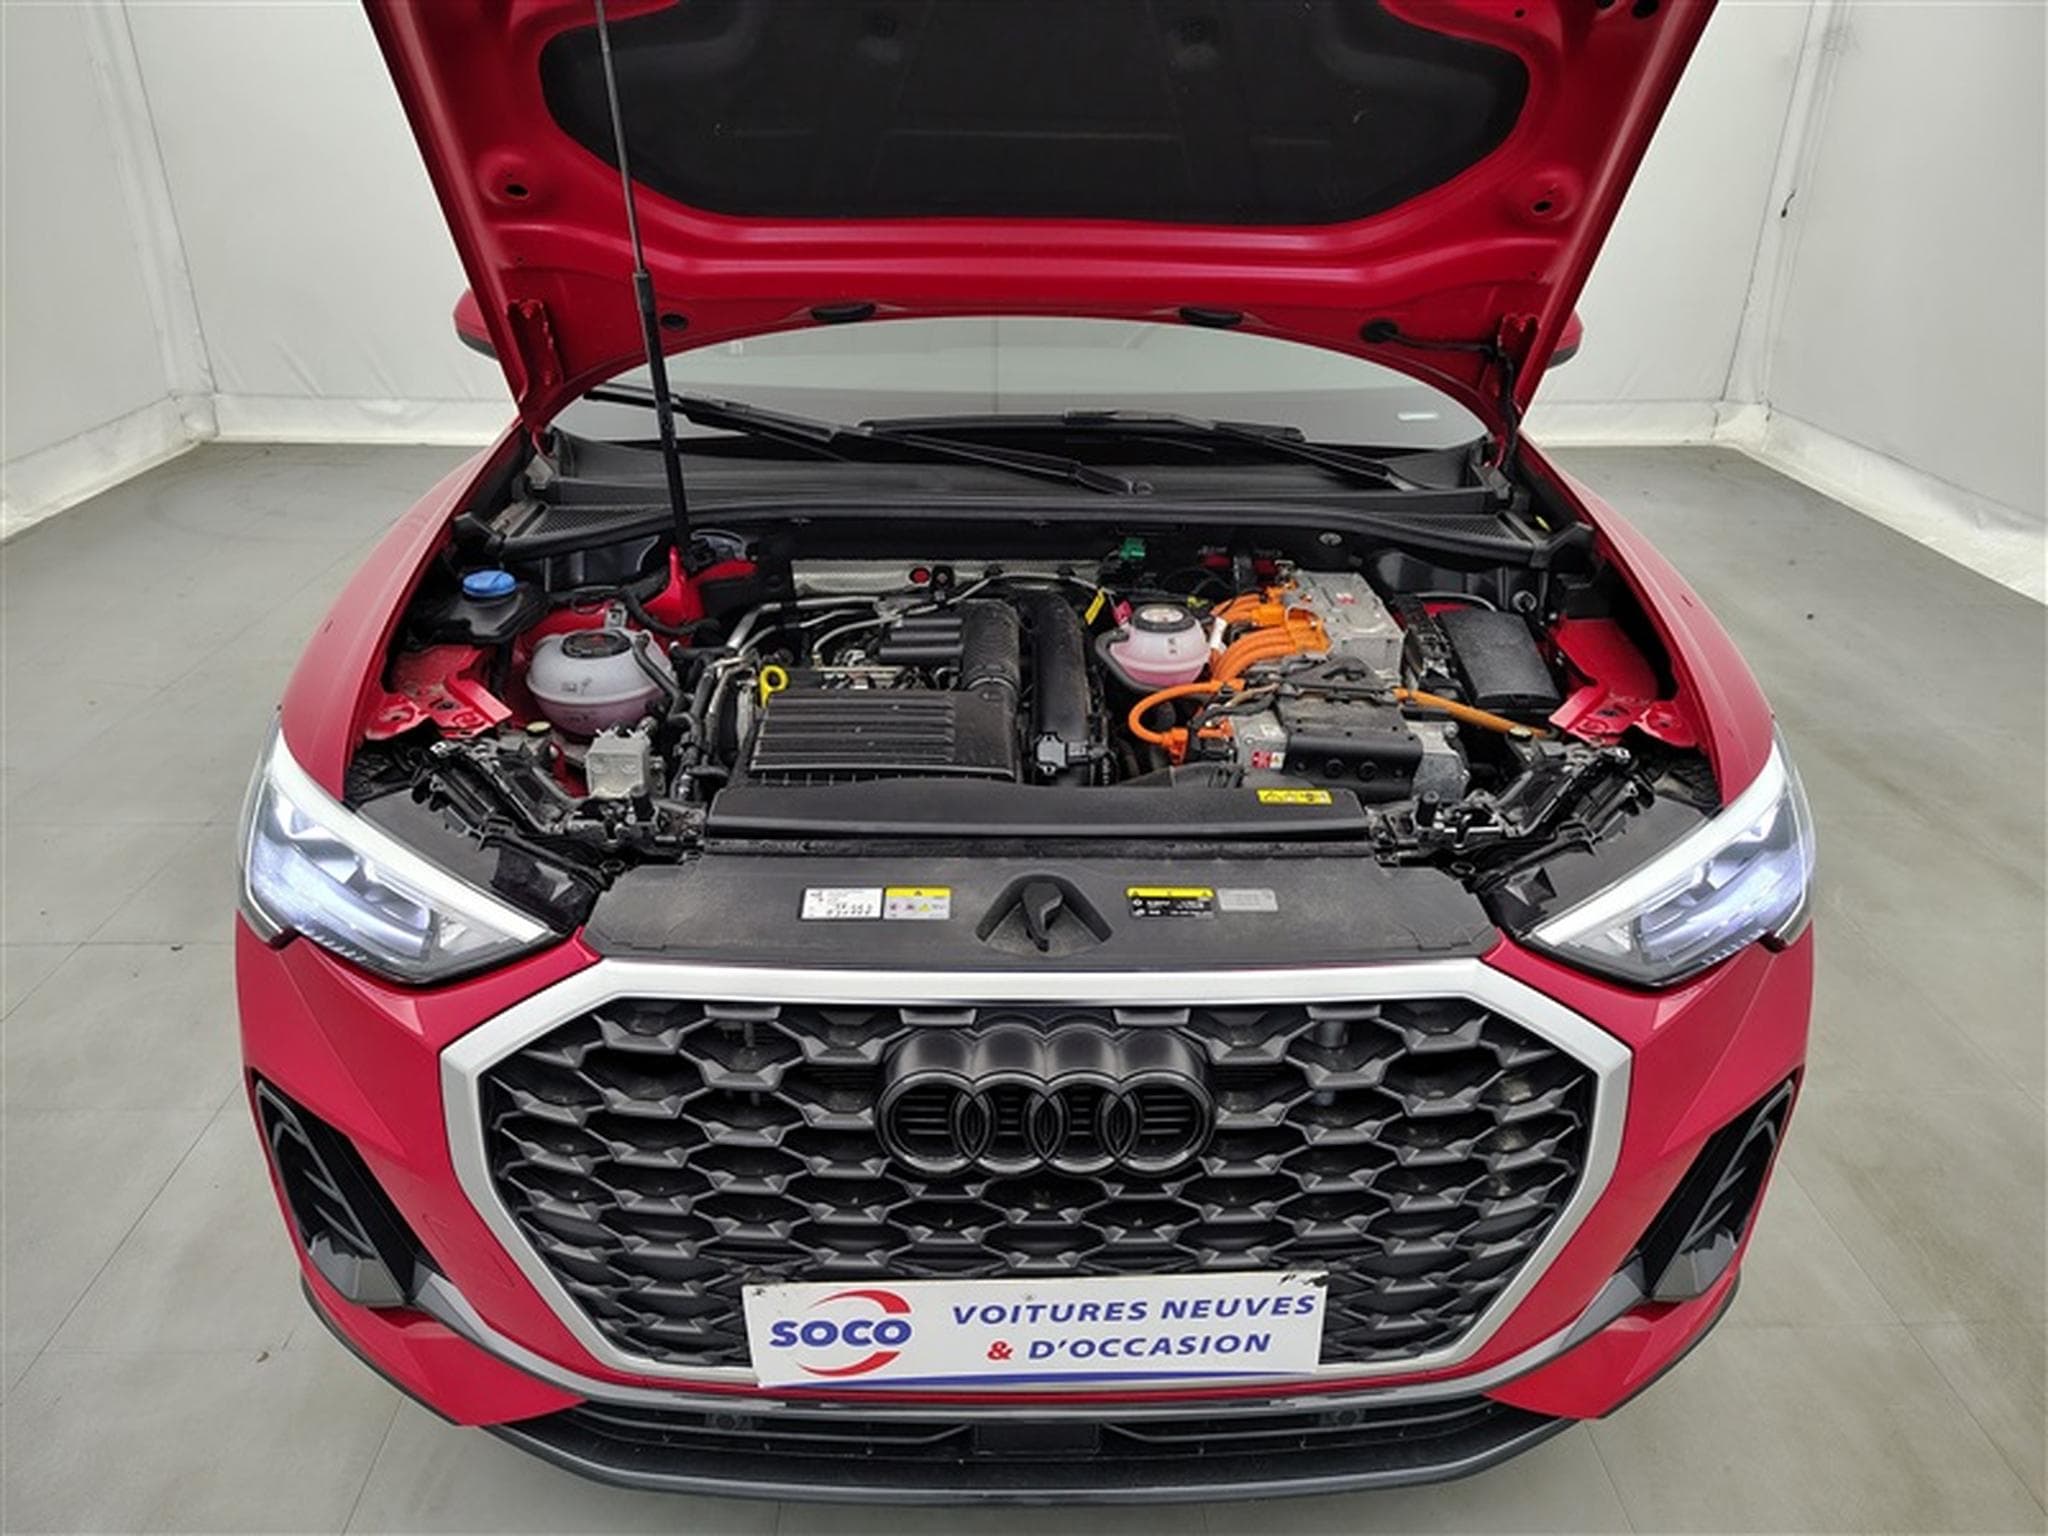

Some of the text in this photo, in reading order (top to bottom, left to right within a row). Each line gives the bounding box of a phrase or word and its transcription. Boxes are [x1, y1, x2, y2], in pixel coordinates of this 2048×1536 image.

[953, 1295, 1315, 1325] VOITURES NEUVES
[769, 1319, 912, 1347] SOCO
[986, 1333, 1270, 1360] & D'OCCASION
